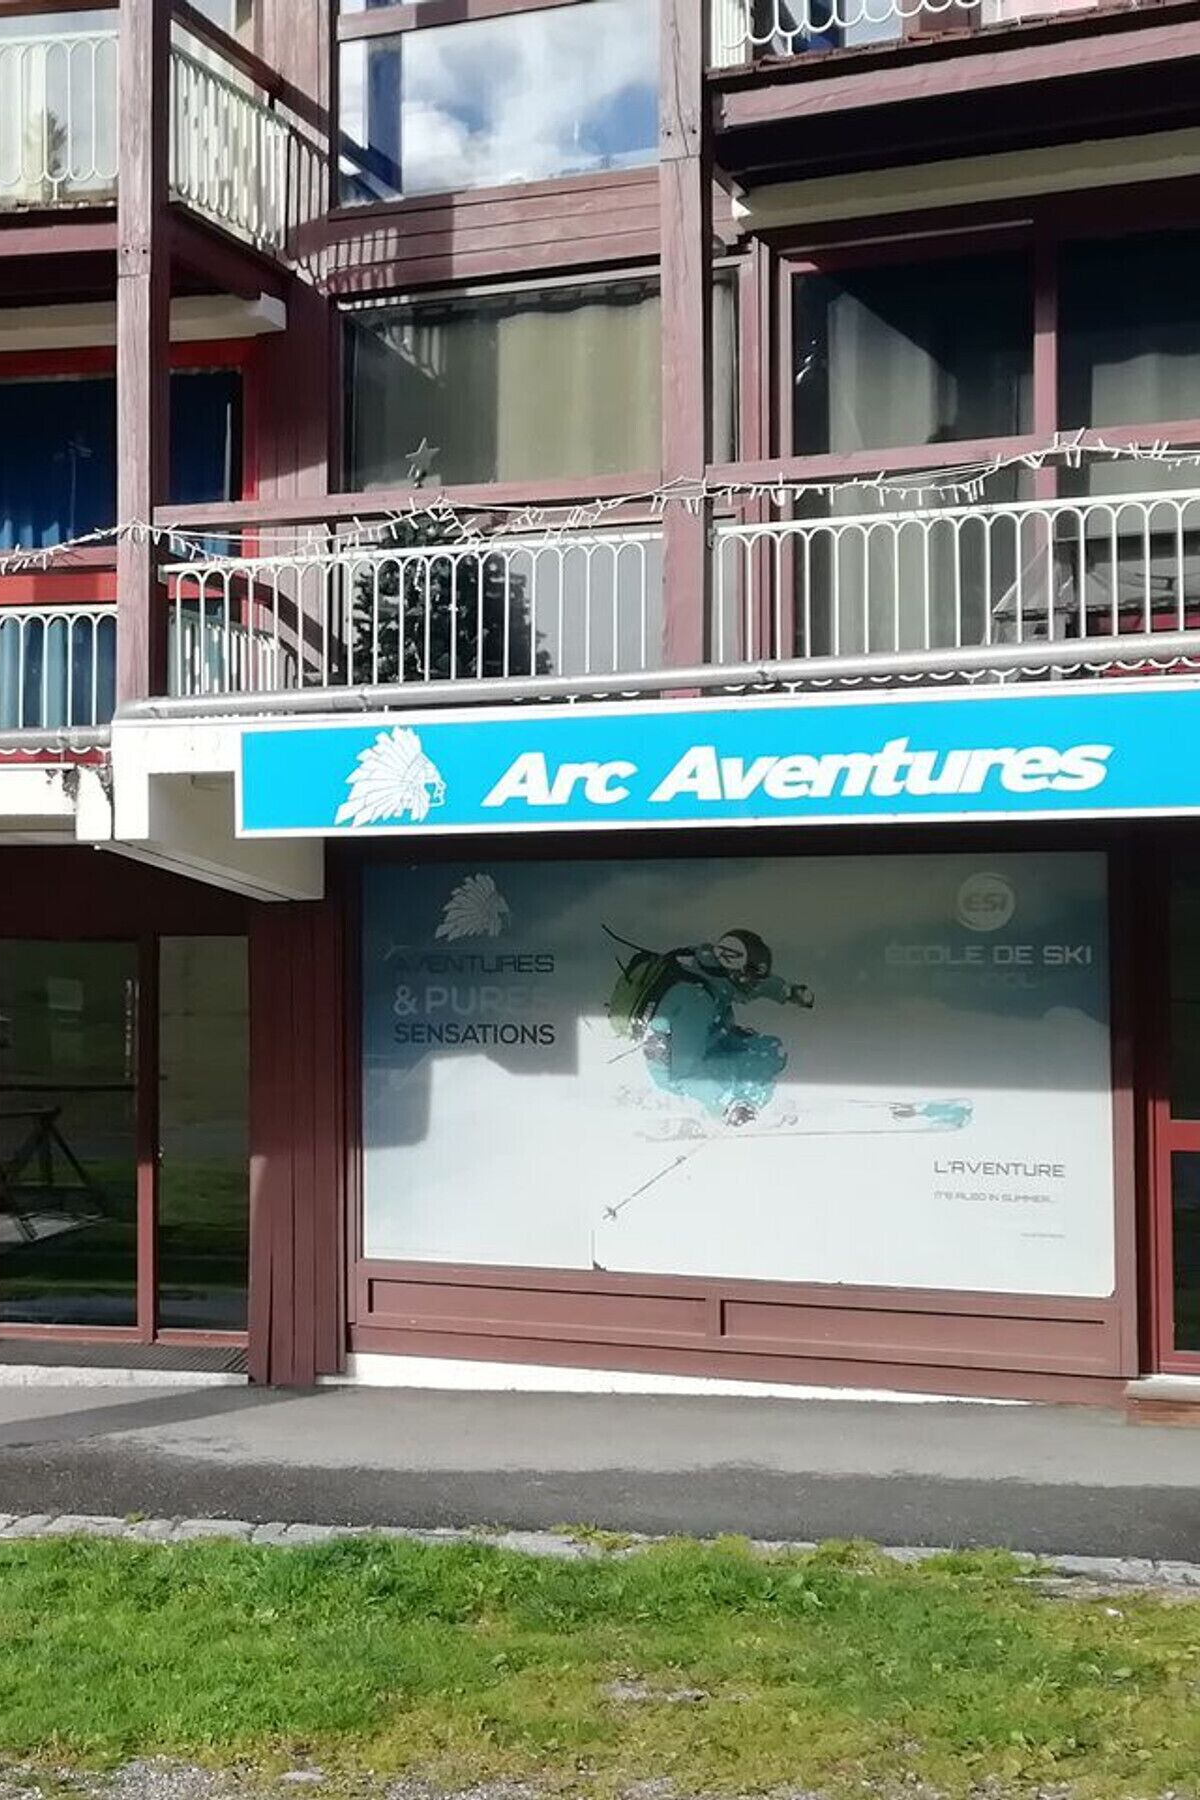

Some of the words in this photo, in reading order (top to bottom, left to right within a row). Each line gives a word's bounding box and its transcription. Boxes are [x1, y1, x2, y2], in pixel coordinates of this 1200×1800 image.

[480, 752, 637, 807] Arc
[647, 737, 1114, 802] Aventures
[393, 953, 555, 974] AVENTURES
[993, 944, 1034, 965] DE
[1042, 944, 1093, 965] SKI
[393, 1023, 556, 1045] SENSATIONS
[934, 1160, 1066, 1178] L'AVENTURE
